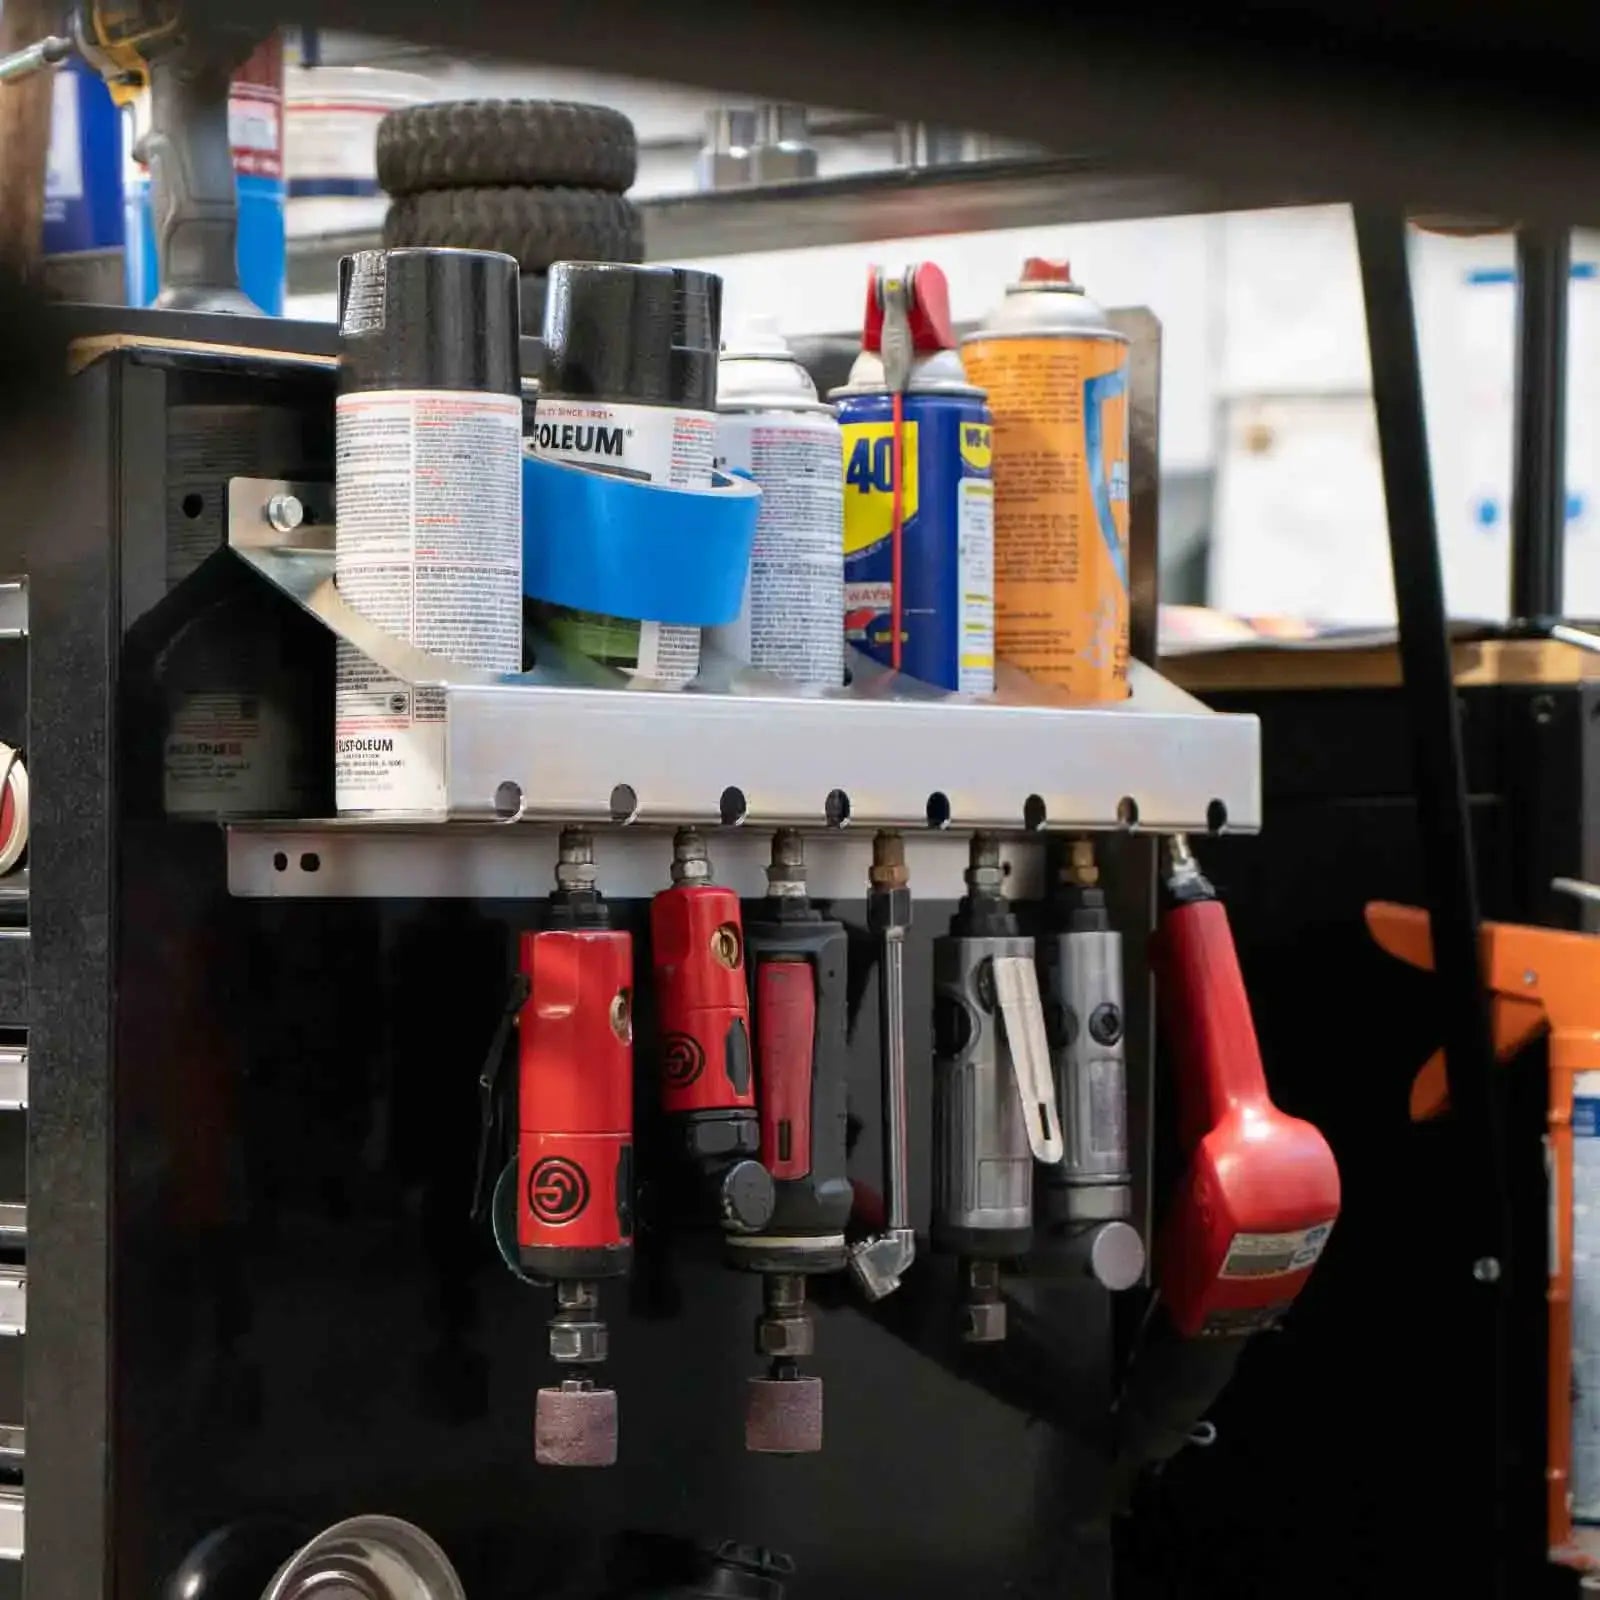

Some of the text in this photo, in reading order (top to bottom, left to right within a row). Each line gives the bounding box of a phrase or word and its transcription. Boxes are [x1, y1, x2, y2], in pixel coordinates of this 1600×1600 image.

[558, 408, 583, 418] SINCE
[846, 436, 894, 494] 40
[338, 739, 394, 753] RUST-OLEUM
